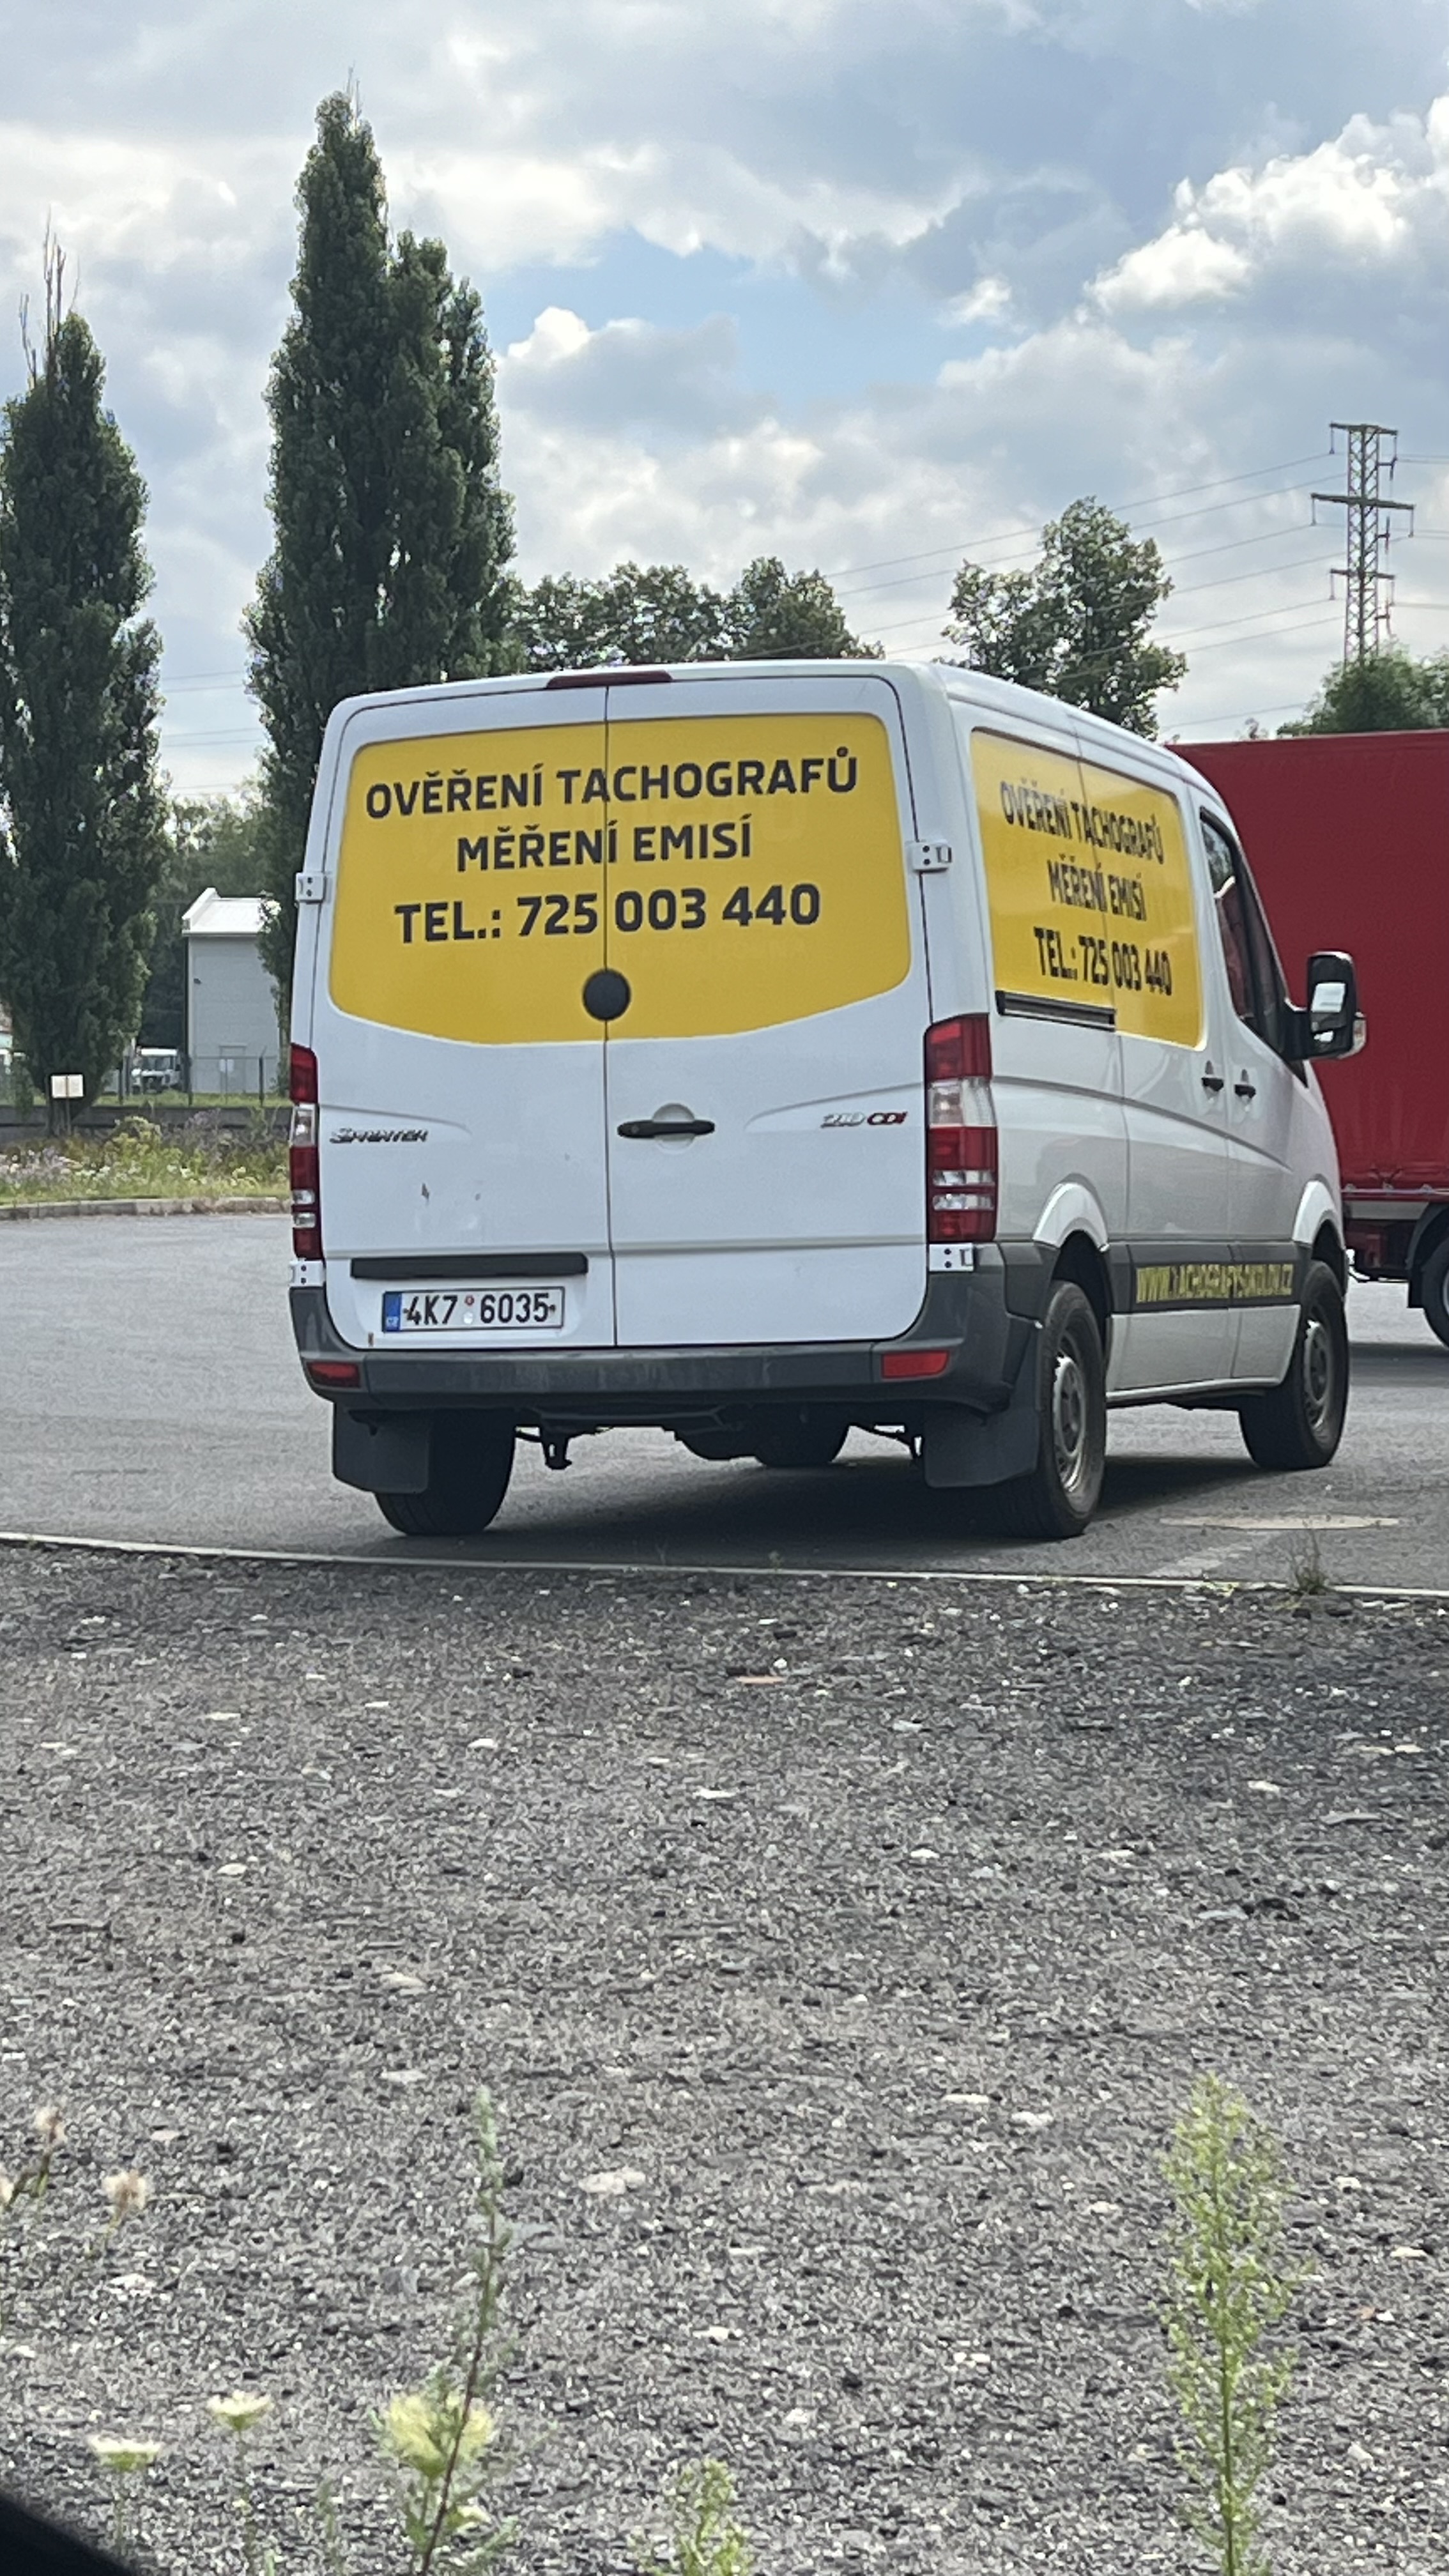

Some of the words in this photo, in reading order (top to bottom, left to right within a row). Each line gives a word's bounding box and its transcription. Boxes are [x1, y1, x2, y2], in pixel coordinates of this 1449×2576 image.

[365, 763, 543, 818] OVĚŘENÍ
[556, 746, 857, 804] TACHOGRAFŮ
[456, 822, 618, 871] MĚŘENÍ
[634, 814, 752, 861] EMISÍ
[1000, 777, 1073, 839] OVĚŘENÍ
[1070, 801, 1164, 864] TACHOGRAFŮ
[395, 901, 502, 943] TEL.:
[518, 893, 598, 936] 725
[616, 889, 706, 930] 003
[722, 883, 820, 926] 440
[1046, 852, 1107, 913] MĚŘENÍ
[1107, 872, 1147, 921] EMISÍ
[1034, 926, 1078, 980] TEL.:
[1078, 935, 1109, 986] 725
[1111, 940, 1142, 992] 003
[1144, 947, 1172, 995] 440
[406, 1294, 458, 1325] 4K7
[480, 1292, 551, 1324] 6035
